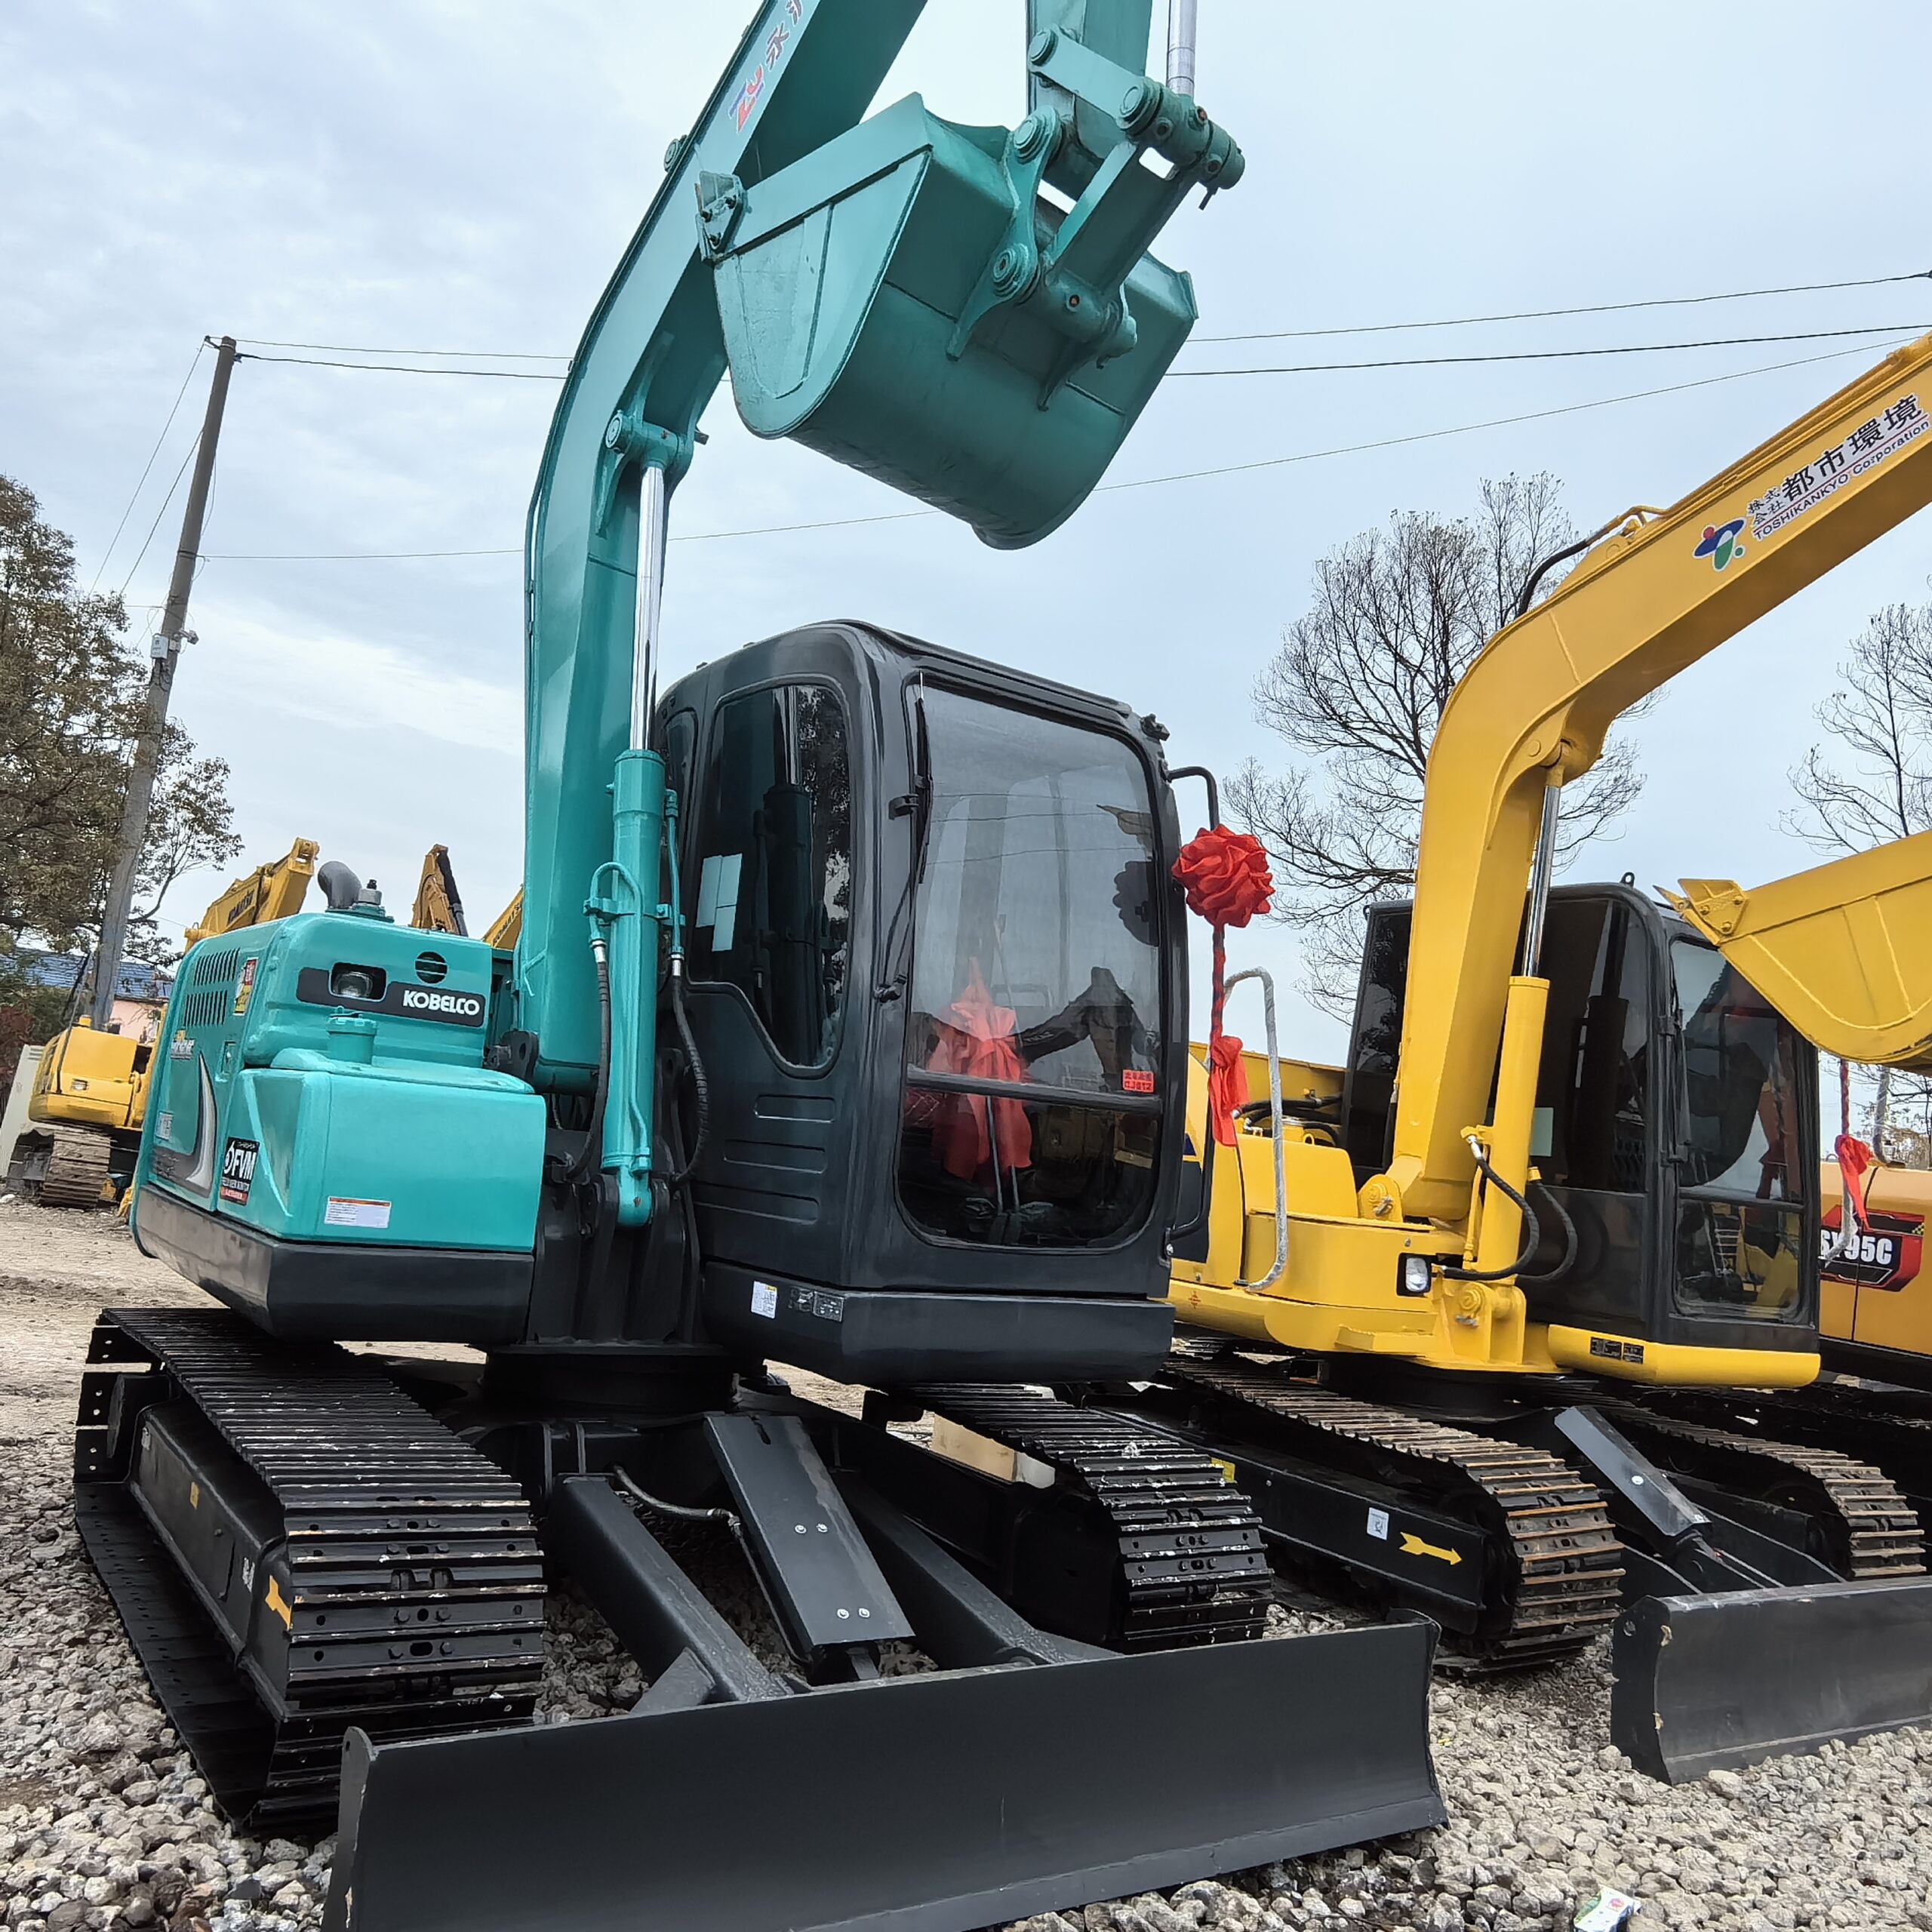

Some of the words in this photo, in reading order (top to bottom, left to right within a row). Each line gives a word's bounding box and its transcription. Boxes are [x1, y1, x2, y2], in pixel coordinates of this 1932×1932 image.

[1753, 474, 1849, 540] TOSHIKANKYO
[1853, 420, 1930, 475] Corporation
[1782, 394, 1922, 501] 都市環境
[402, 989, 480, 1016] KOBELCO
